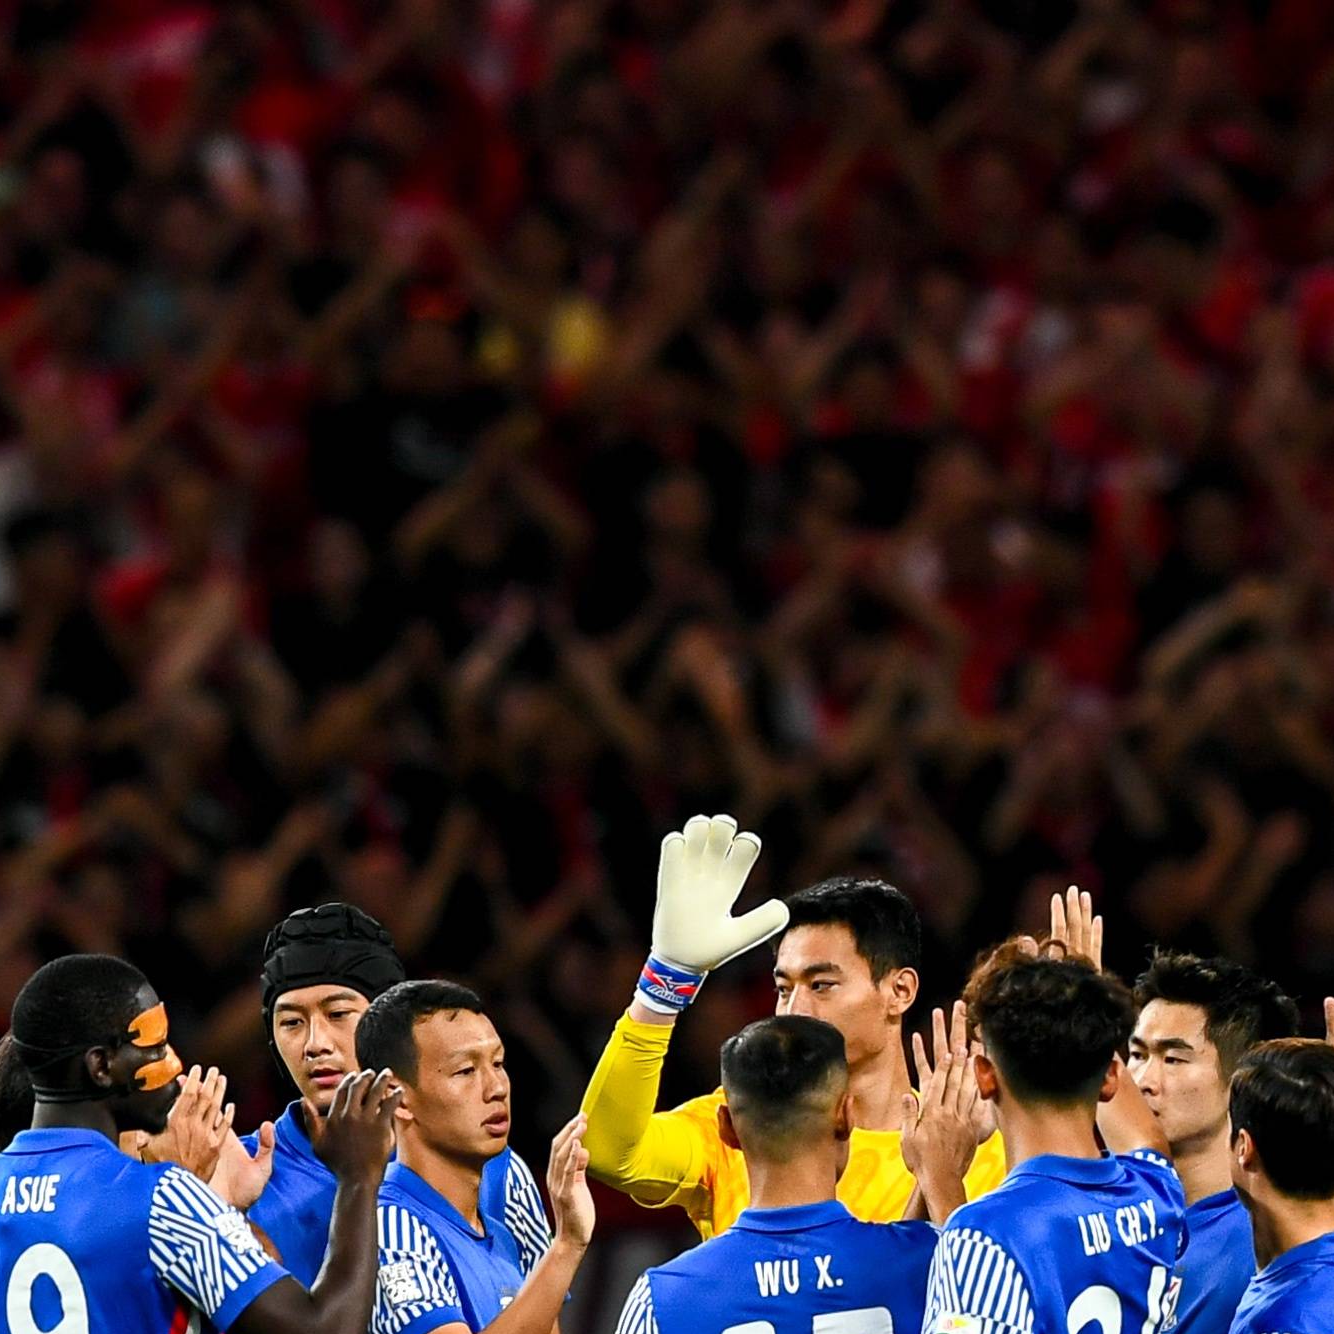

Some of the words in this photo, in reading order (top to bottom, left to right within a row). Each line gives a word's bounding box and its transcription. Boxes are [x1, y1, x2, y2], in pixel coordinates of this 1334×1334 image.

[1, 1174, 61, 1215] ASUE
[1078, 1212, 1111, 1256] LIU
[1115, 1199, 1164, 1247] CH.Y.
[755, 1258, 800, 1297] WU
[814, 1255, 844, 1290] X.
